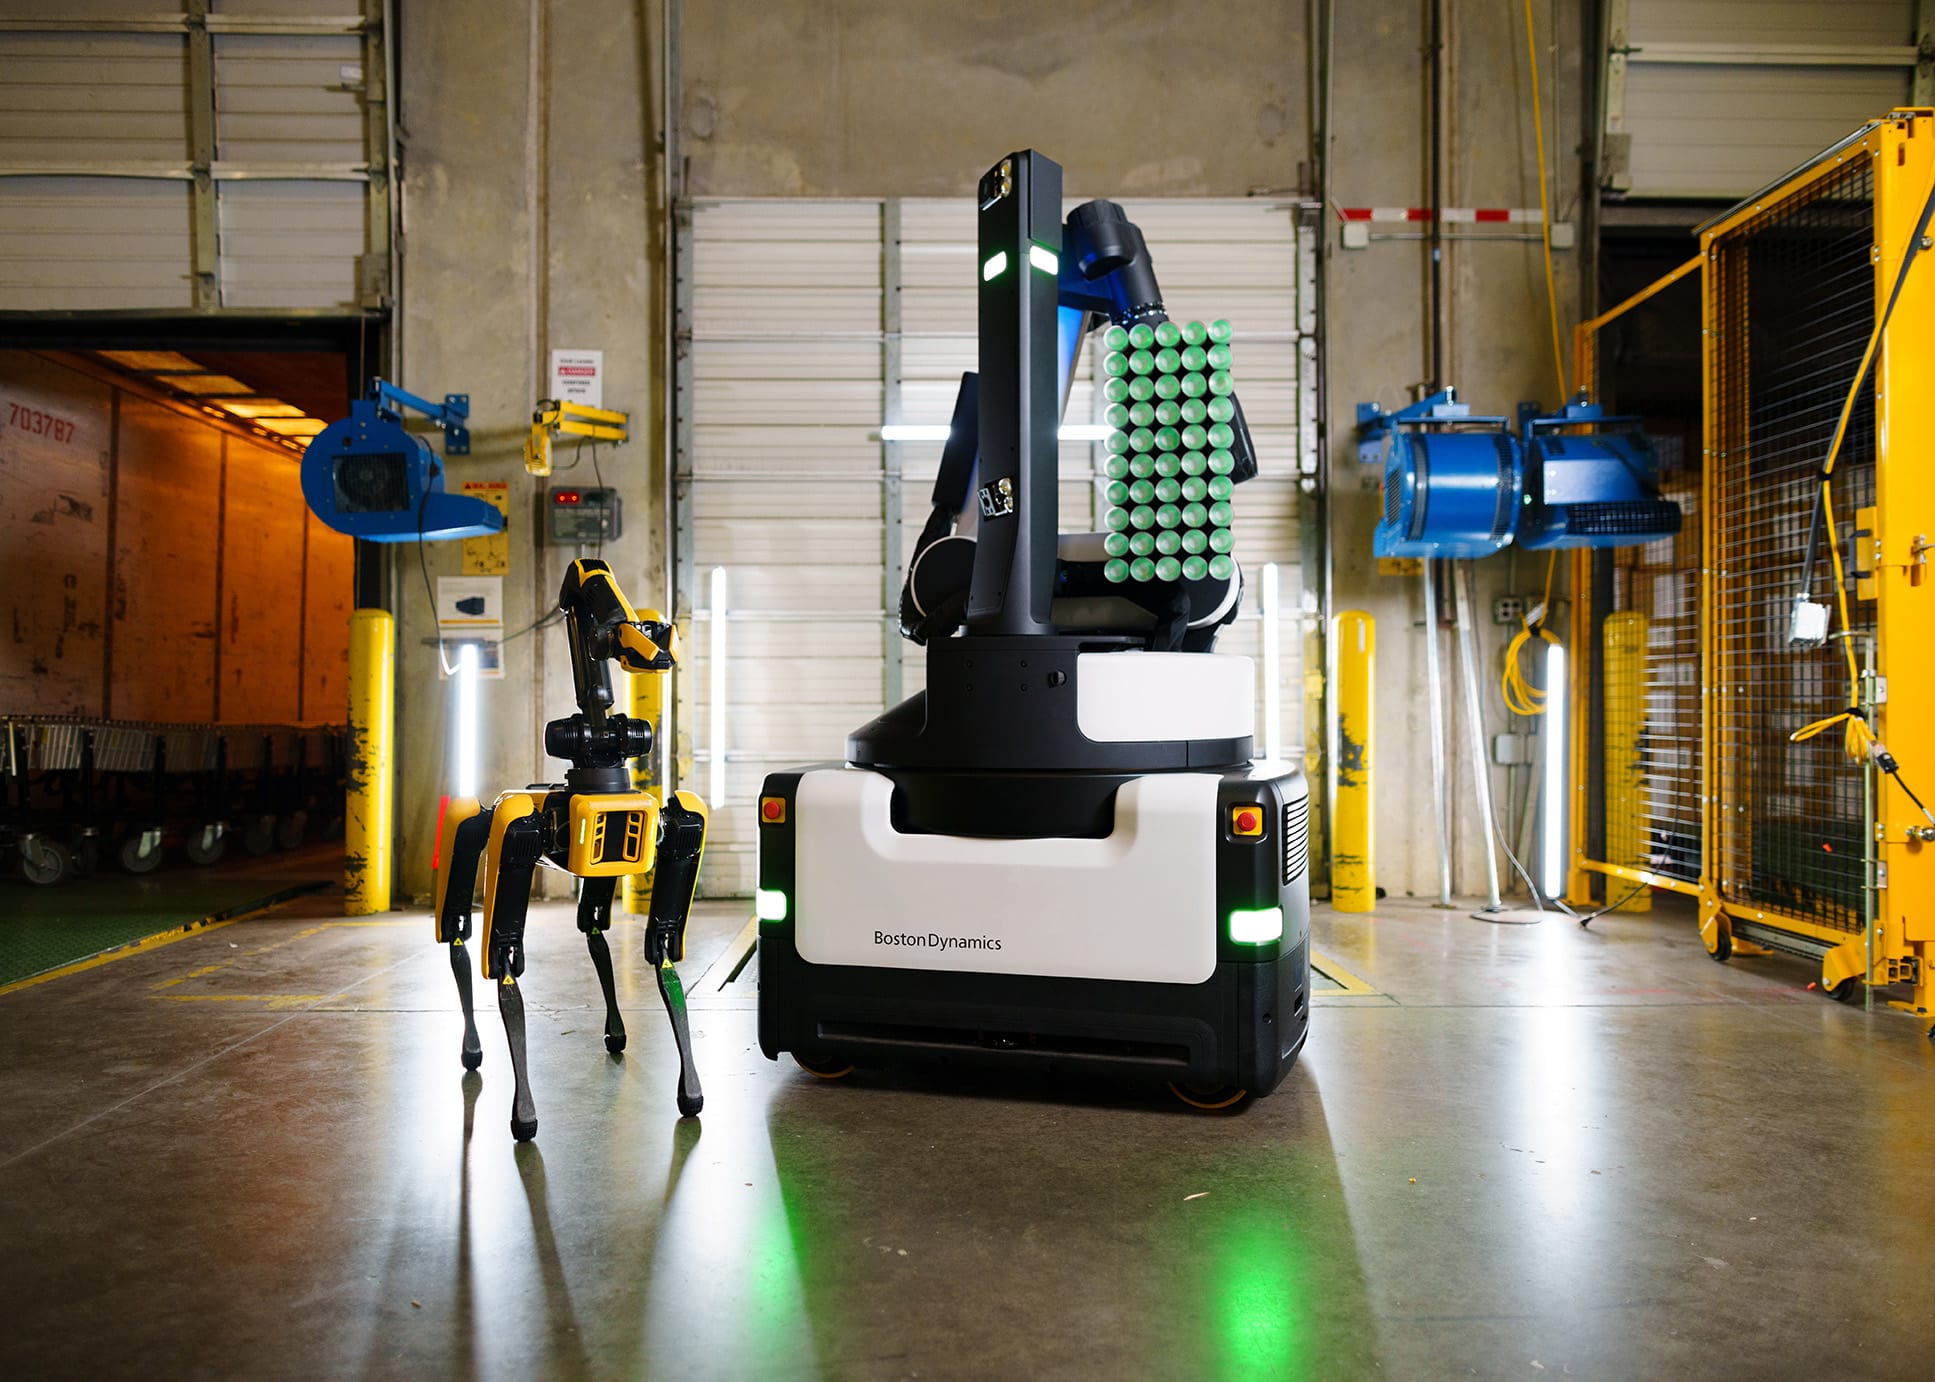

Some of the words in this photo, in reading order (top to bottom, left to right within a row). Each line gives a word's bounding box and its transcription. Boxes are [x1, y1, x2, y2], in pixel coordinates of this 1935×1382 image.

[9, 402, 75, 444] 703787
[874, 930, 926, 947] Boston
[928, 933, 1002, 952] Dynamics
